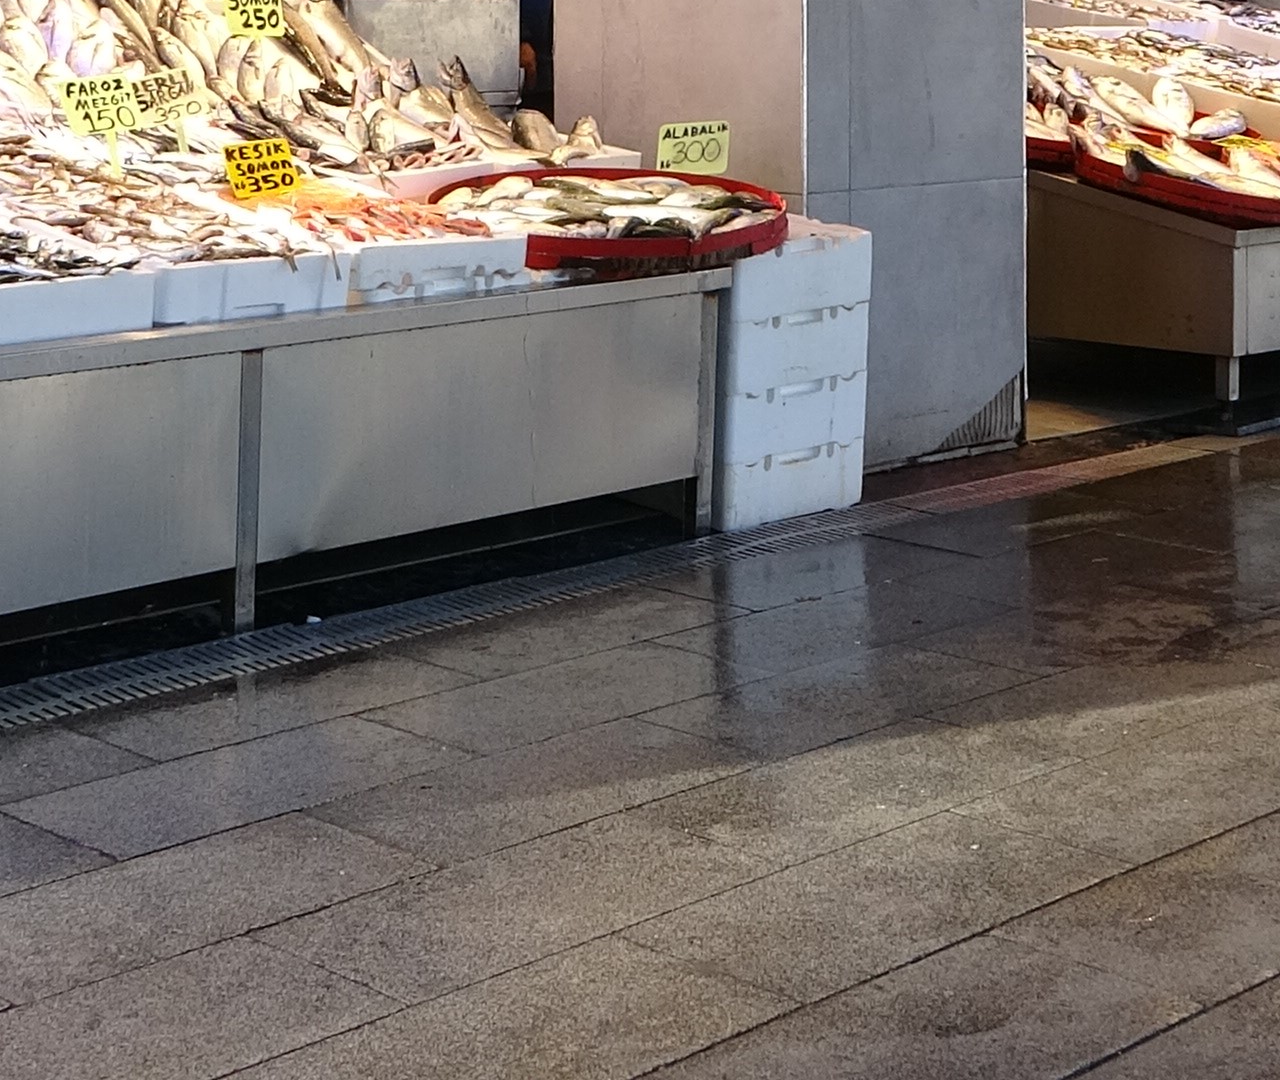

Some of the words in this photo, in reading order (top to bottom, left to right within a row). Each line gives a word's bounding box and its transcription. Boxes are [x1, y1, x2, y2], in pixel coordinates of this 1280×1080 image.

[239, 8, 280, 31] 250
[66, 78, 124, 99] FAROZ
[82, 105, 136, 134] 150
[153, 100, 202, 124] 350
[671, 138, 721, 164] 300
[246, 172, 294, 193] 350
